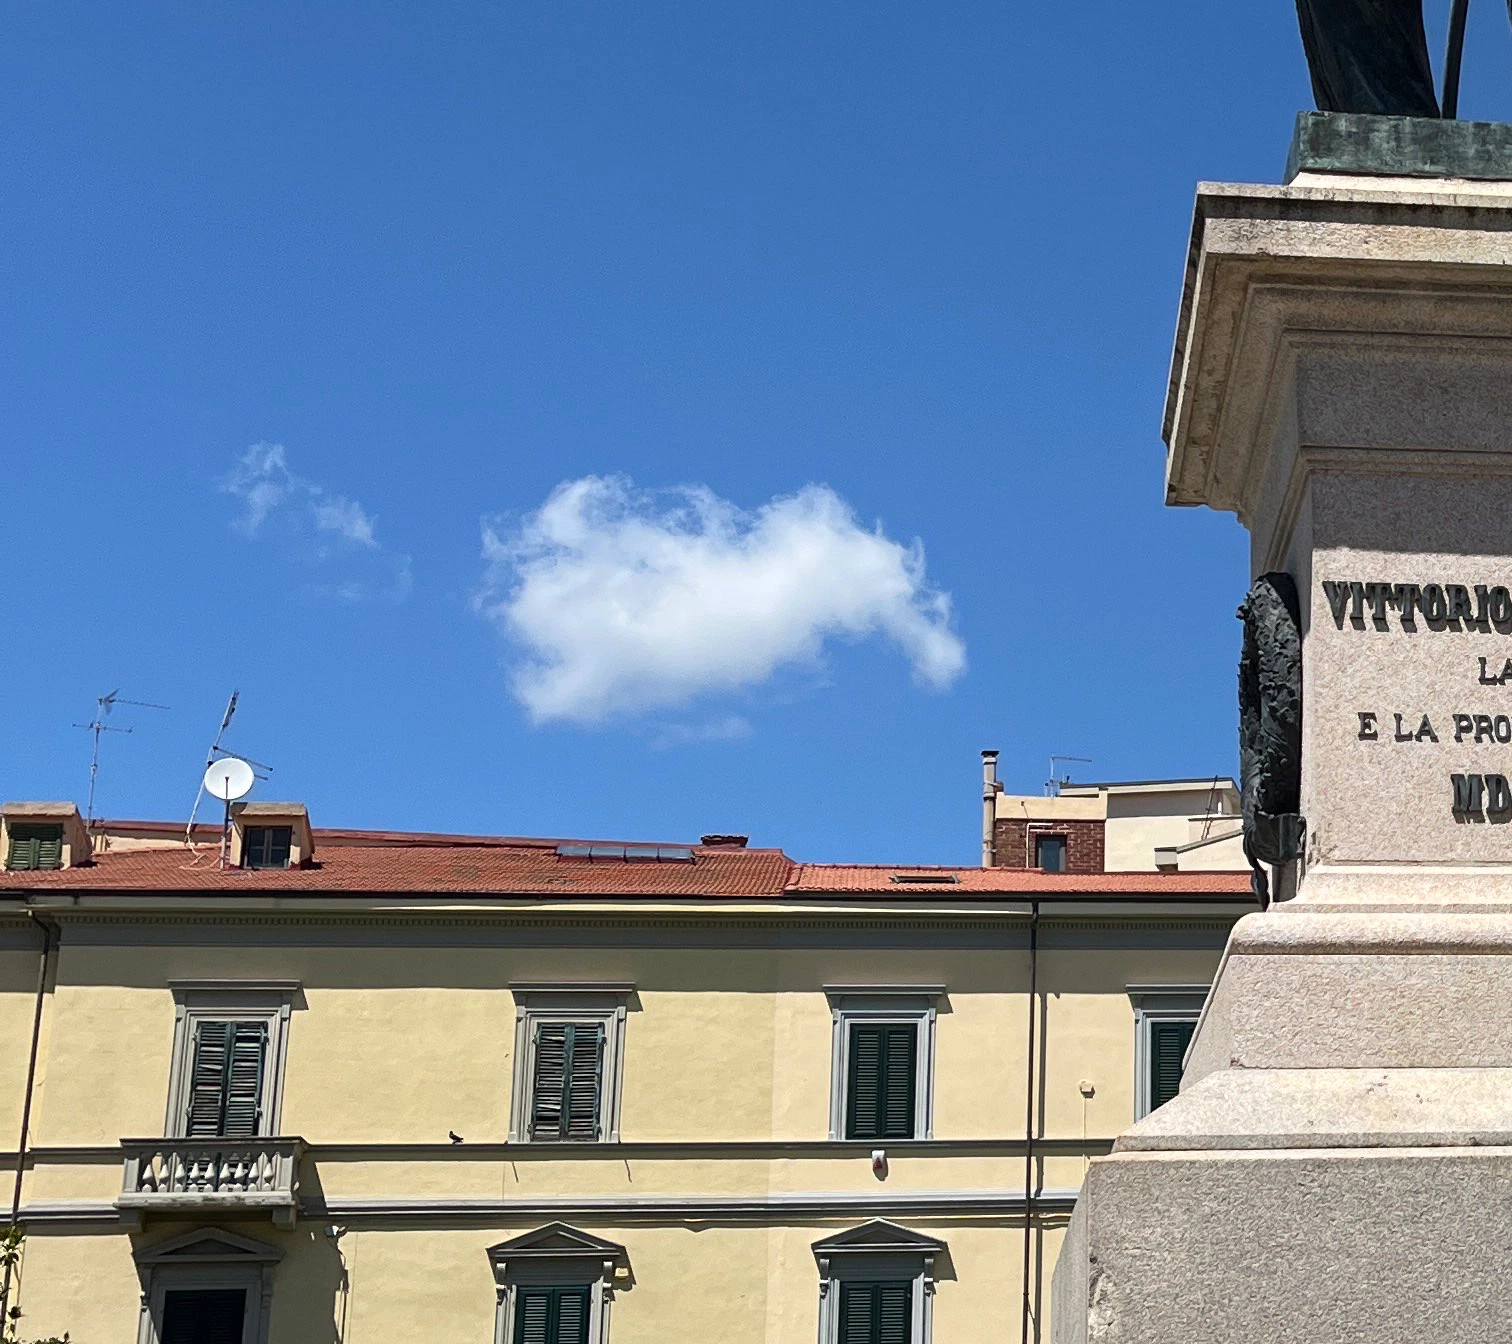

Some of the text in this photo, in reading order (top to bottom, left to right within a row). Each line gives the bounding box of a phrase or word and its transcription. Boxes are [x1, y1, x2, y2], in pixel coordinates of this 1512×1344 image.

[1323, 581, 1512, 630] VITTORIO
[1358, 712, 1378, 741] E
[1394, 713, 1439, 743] LA
